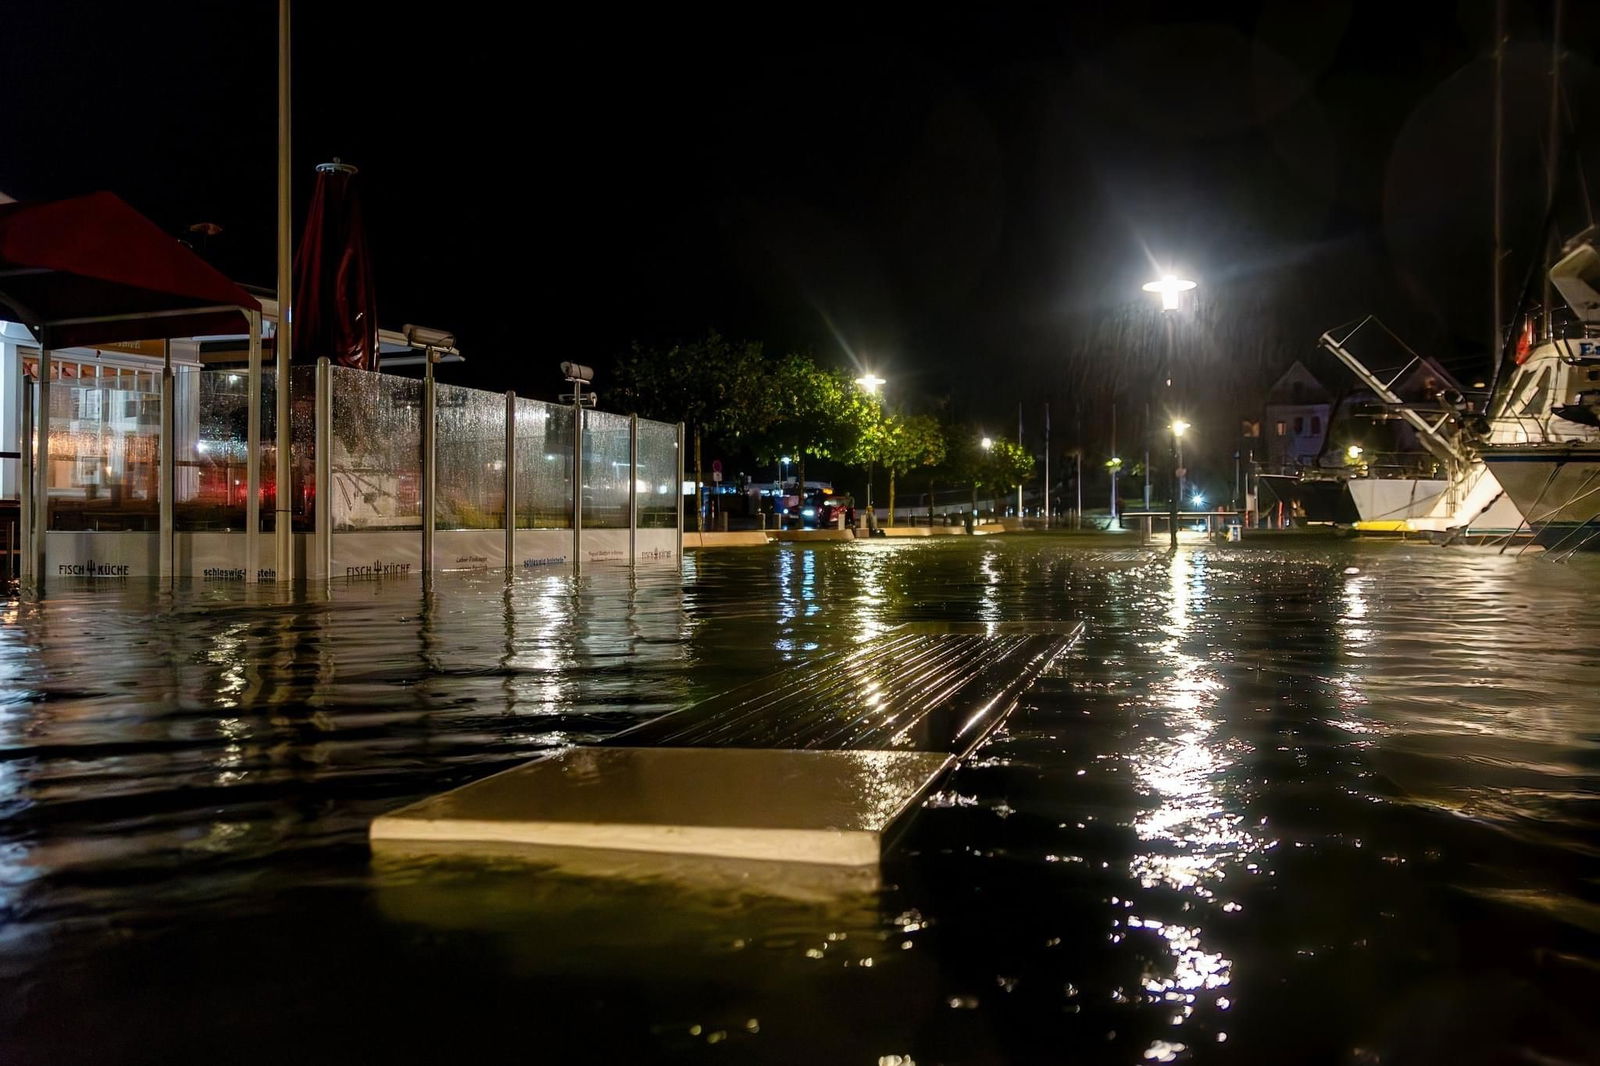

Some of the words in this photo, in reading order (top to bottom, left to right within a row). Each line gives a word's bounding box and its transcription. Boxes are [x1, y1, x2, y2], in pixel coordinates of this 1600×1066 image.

[58, 564, 84, 575] FISCH
[97, 563, 129, 576] KÜCHE
[346, 565, 372, 576] FISCH
